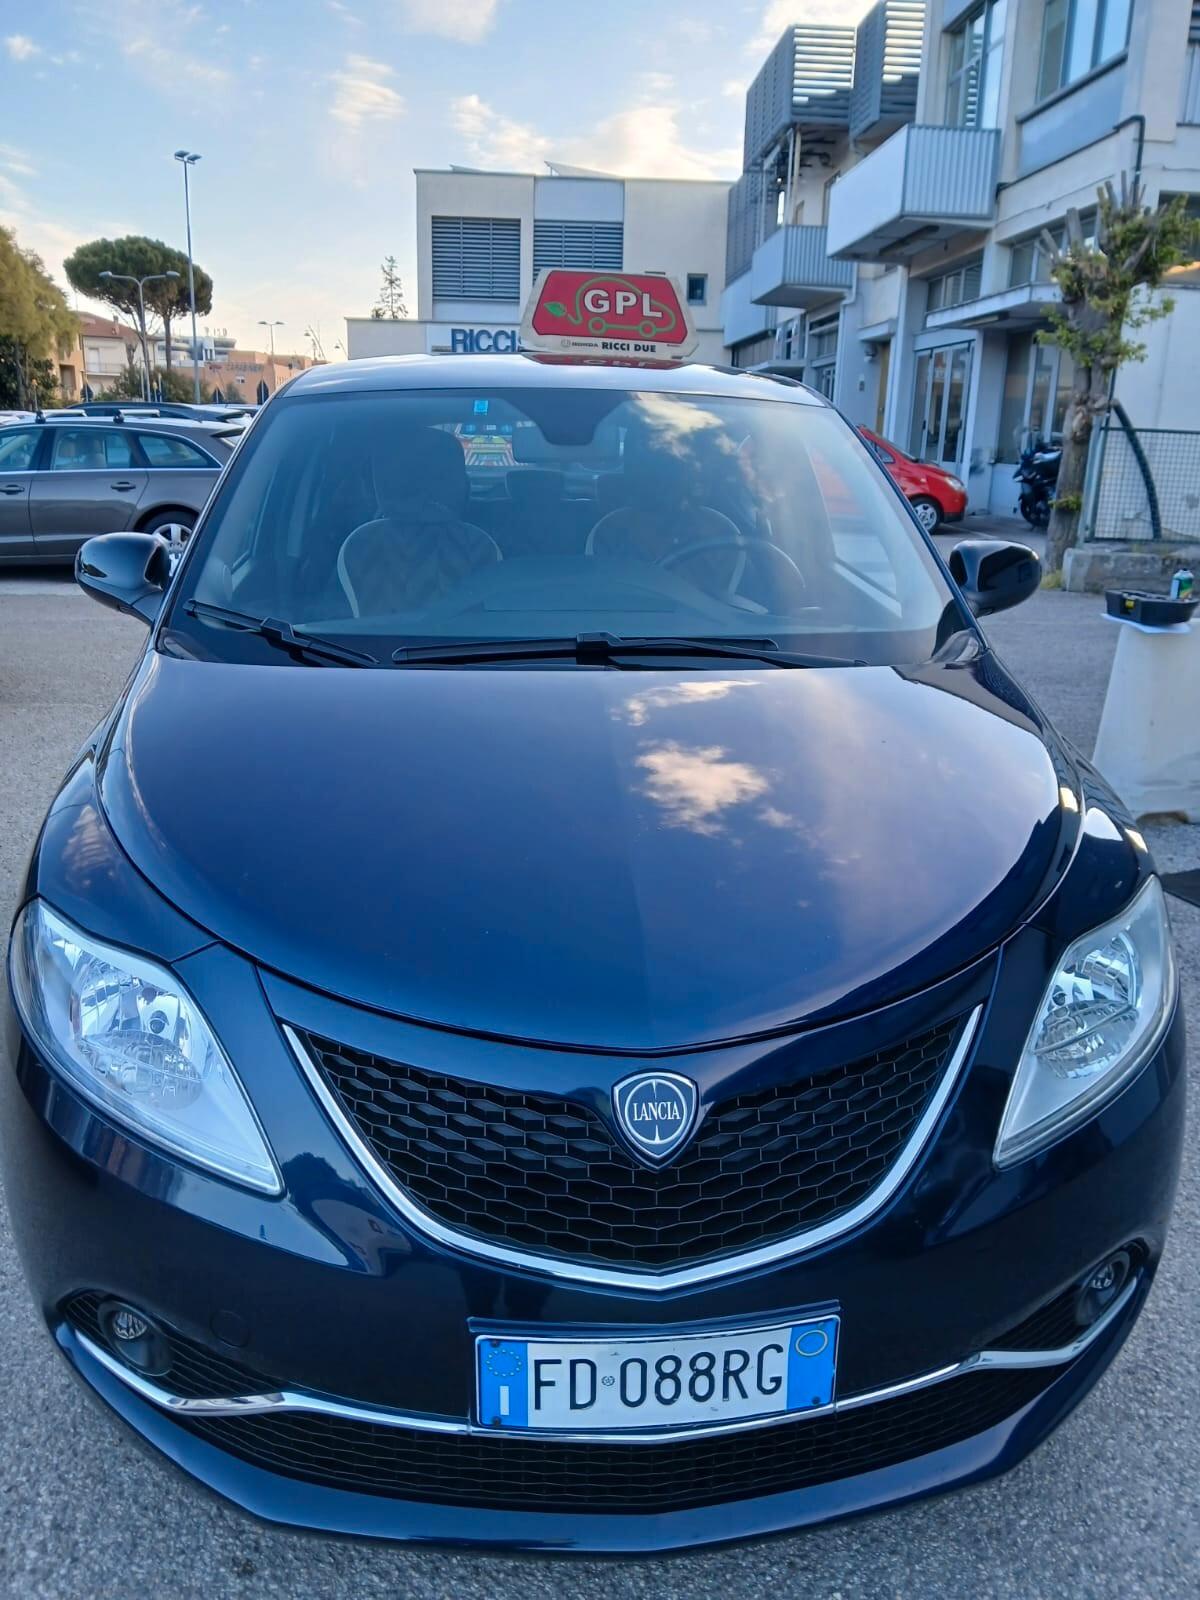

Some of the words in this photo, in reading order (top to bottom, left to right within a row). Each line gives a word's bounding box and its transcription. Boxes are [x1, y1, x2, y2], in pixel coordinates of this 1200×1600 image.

[584, 289, 662, 318] GPL
[601, 341, 630, 351] RICCI
[633, 343, 656, 353] DUE
[632, 1101, 681, 1121] LANCIA
